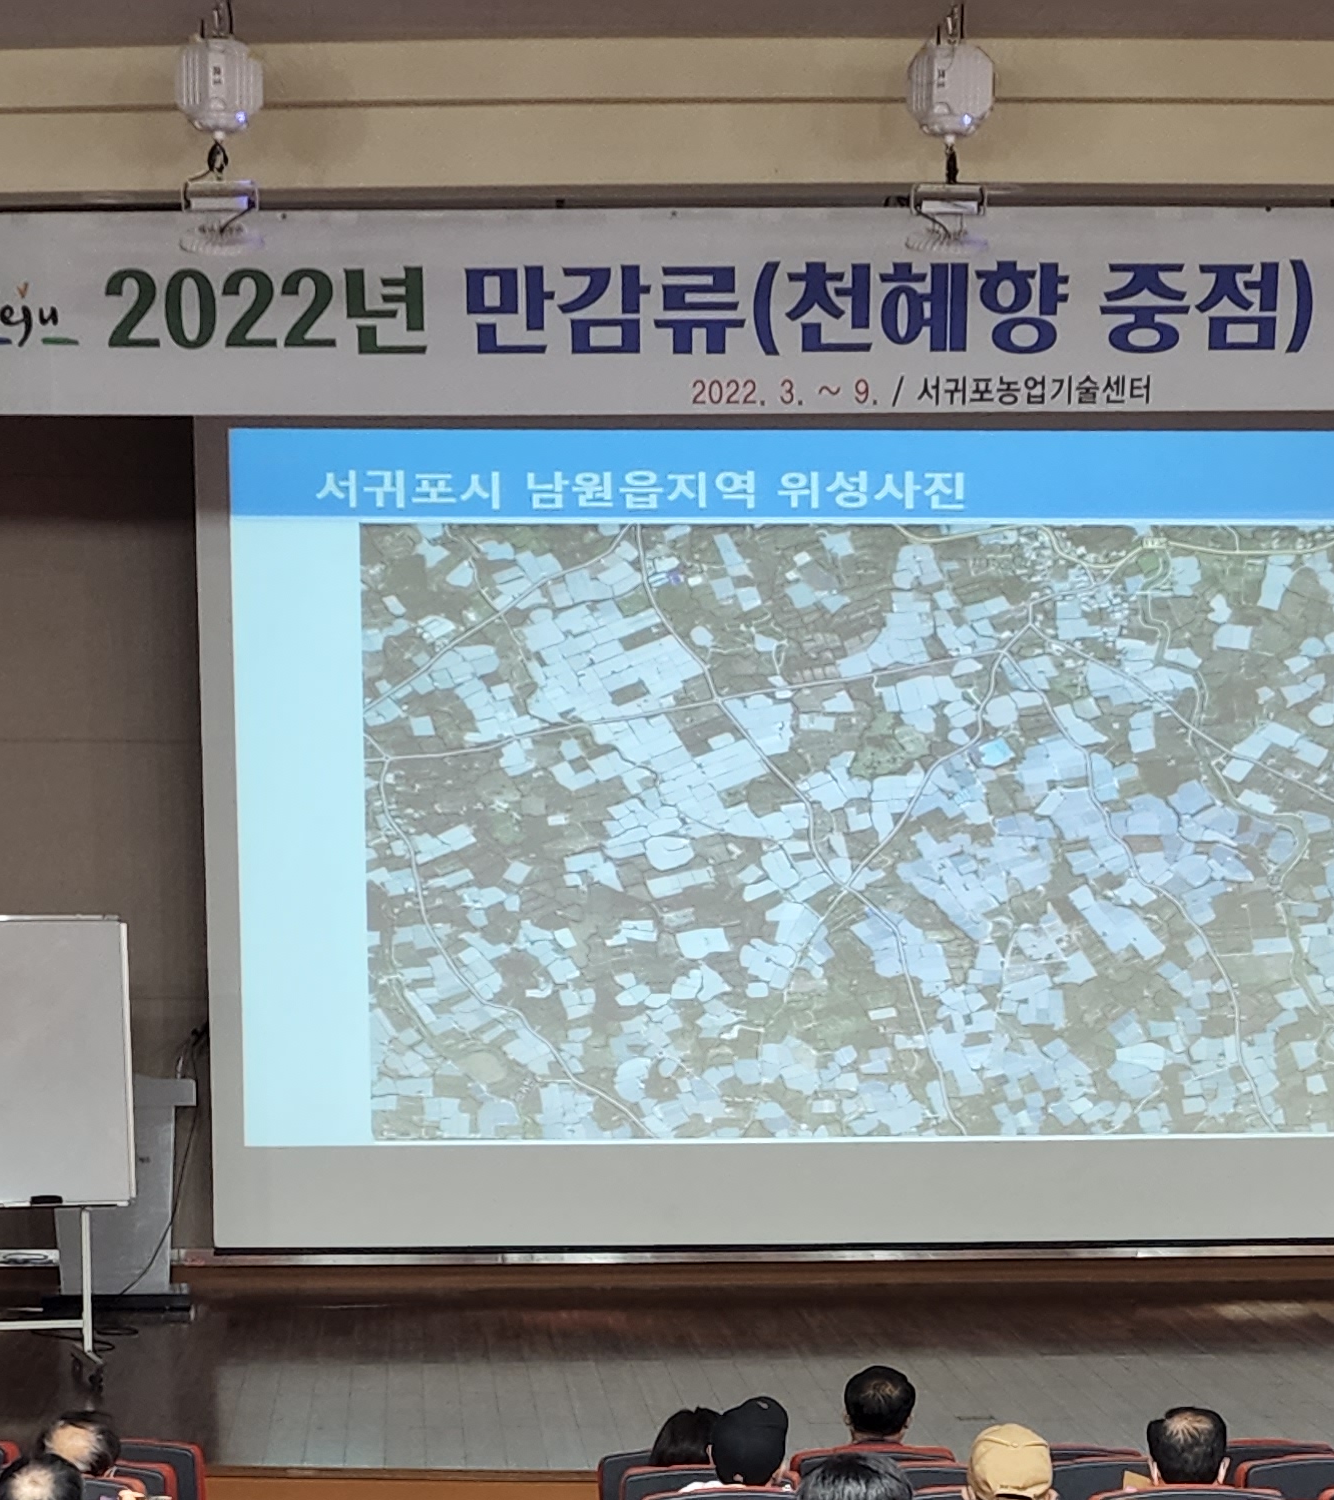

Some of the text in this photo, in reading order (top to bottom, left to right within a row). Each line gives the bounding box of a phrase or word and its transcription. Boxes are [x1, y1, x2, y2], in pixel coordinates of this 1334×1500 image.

[104, 265, 428, 355] 2022년
[464, 260, 1070, 357] 만감류(천혜향
[1098, 259, 1314, 355] 중점)
[691, 378, 766, 407] 2022.
[779, 378, 804, 407] 3.
[853, 378, 878, 407] 9.
[916, 374, 1153, 406] 서귀포농업기술센터
[316, 469, 967, 510] 서귀포시 남원읍지역 위성사진
